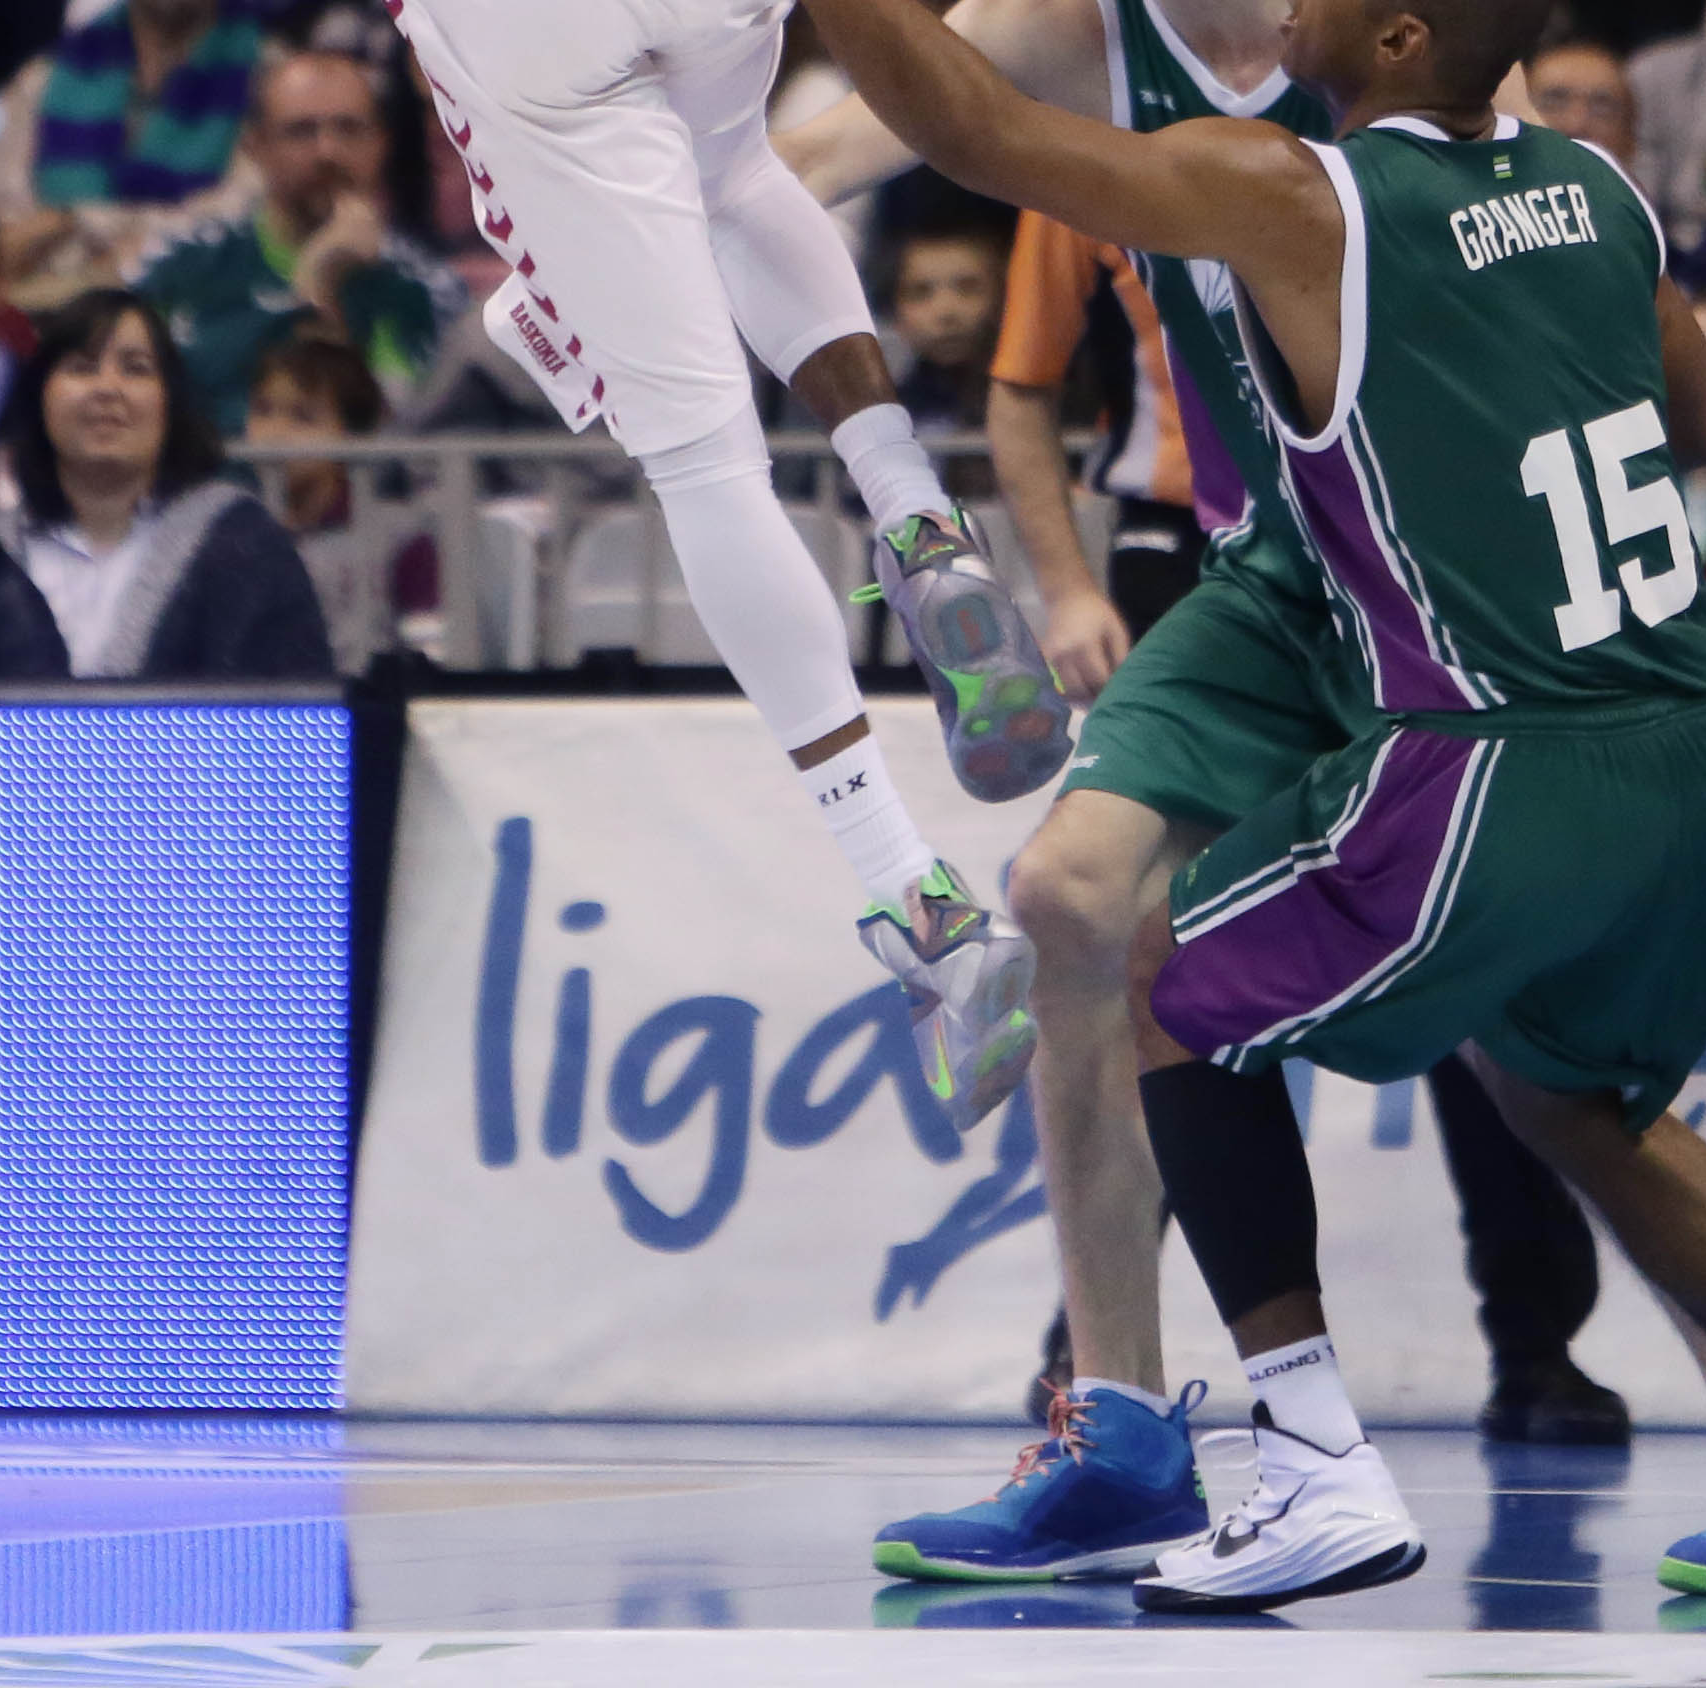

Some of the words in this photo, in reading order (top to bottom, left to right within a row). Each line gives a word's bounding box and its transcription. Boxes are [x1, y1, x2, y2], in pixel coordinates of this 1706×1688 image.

[1449, 183, 1598, 272] GRANGER
[1519, 399, 1699, 653] 15
[474, 816, 964, 1253] liga
